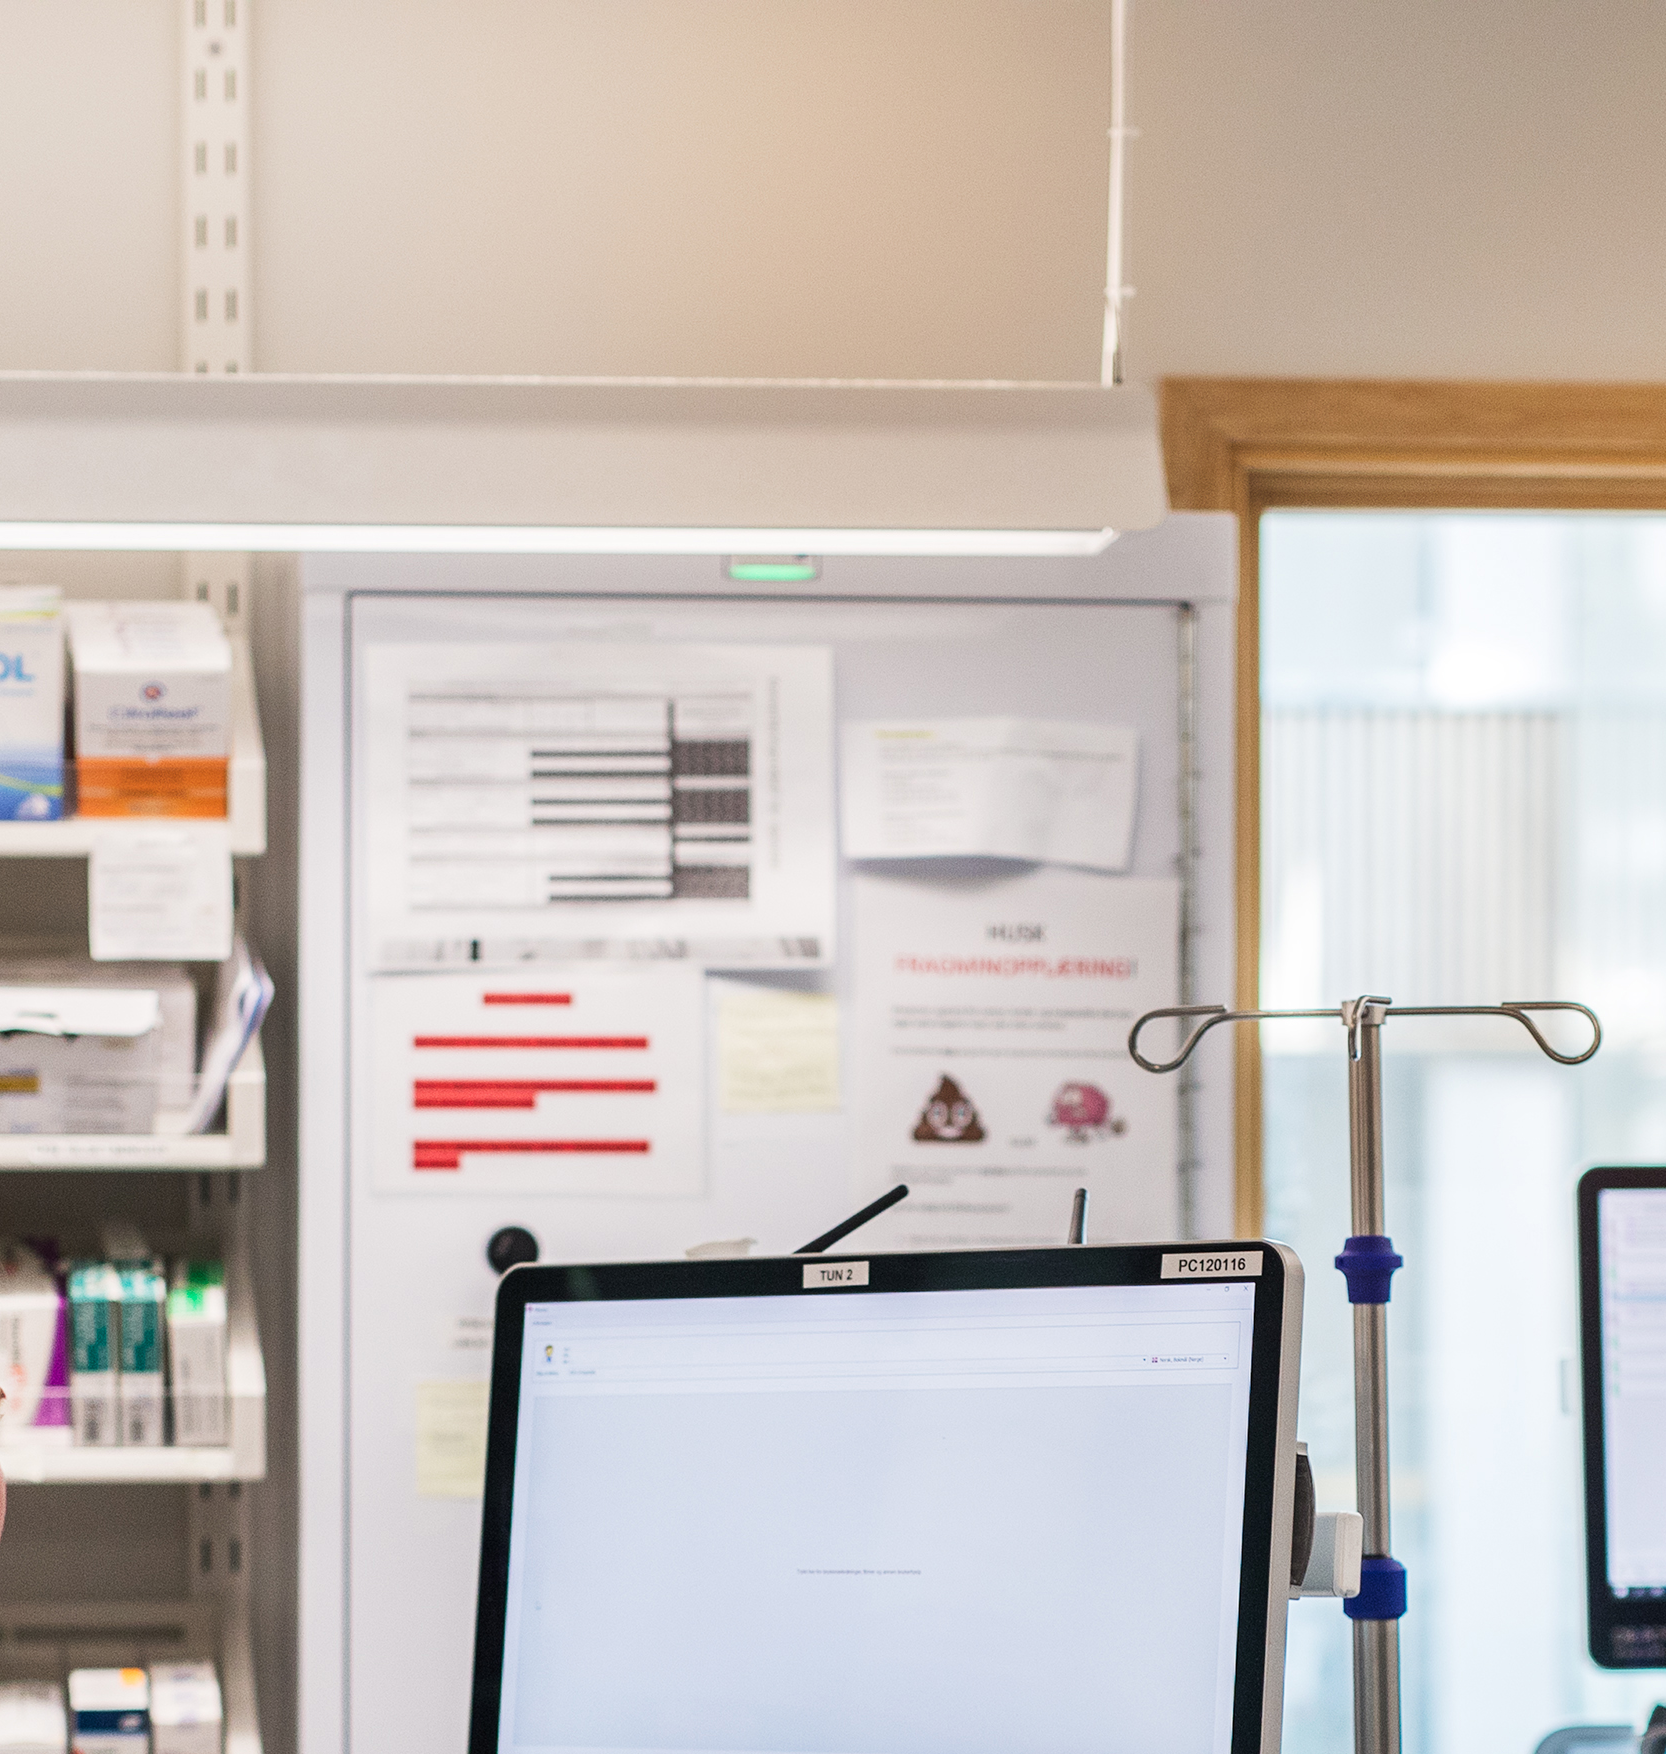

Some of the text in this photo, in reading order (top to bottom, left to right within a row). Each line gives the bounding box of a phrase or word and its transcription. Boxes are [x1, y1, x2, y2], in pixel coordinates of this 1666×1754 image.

[986, 923, 1045, 942] HUSK
[1178, 1258, 1246, 1272] PC120116
[820, 1269, 853, 1281] TUN 2
